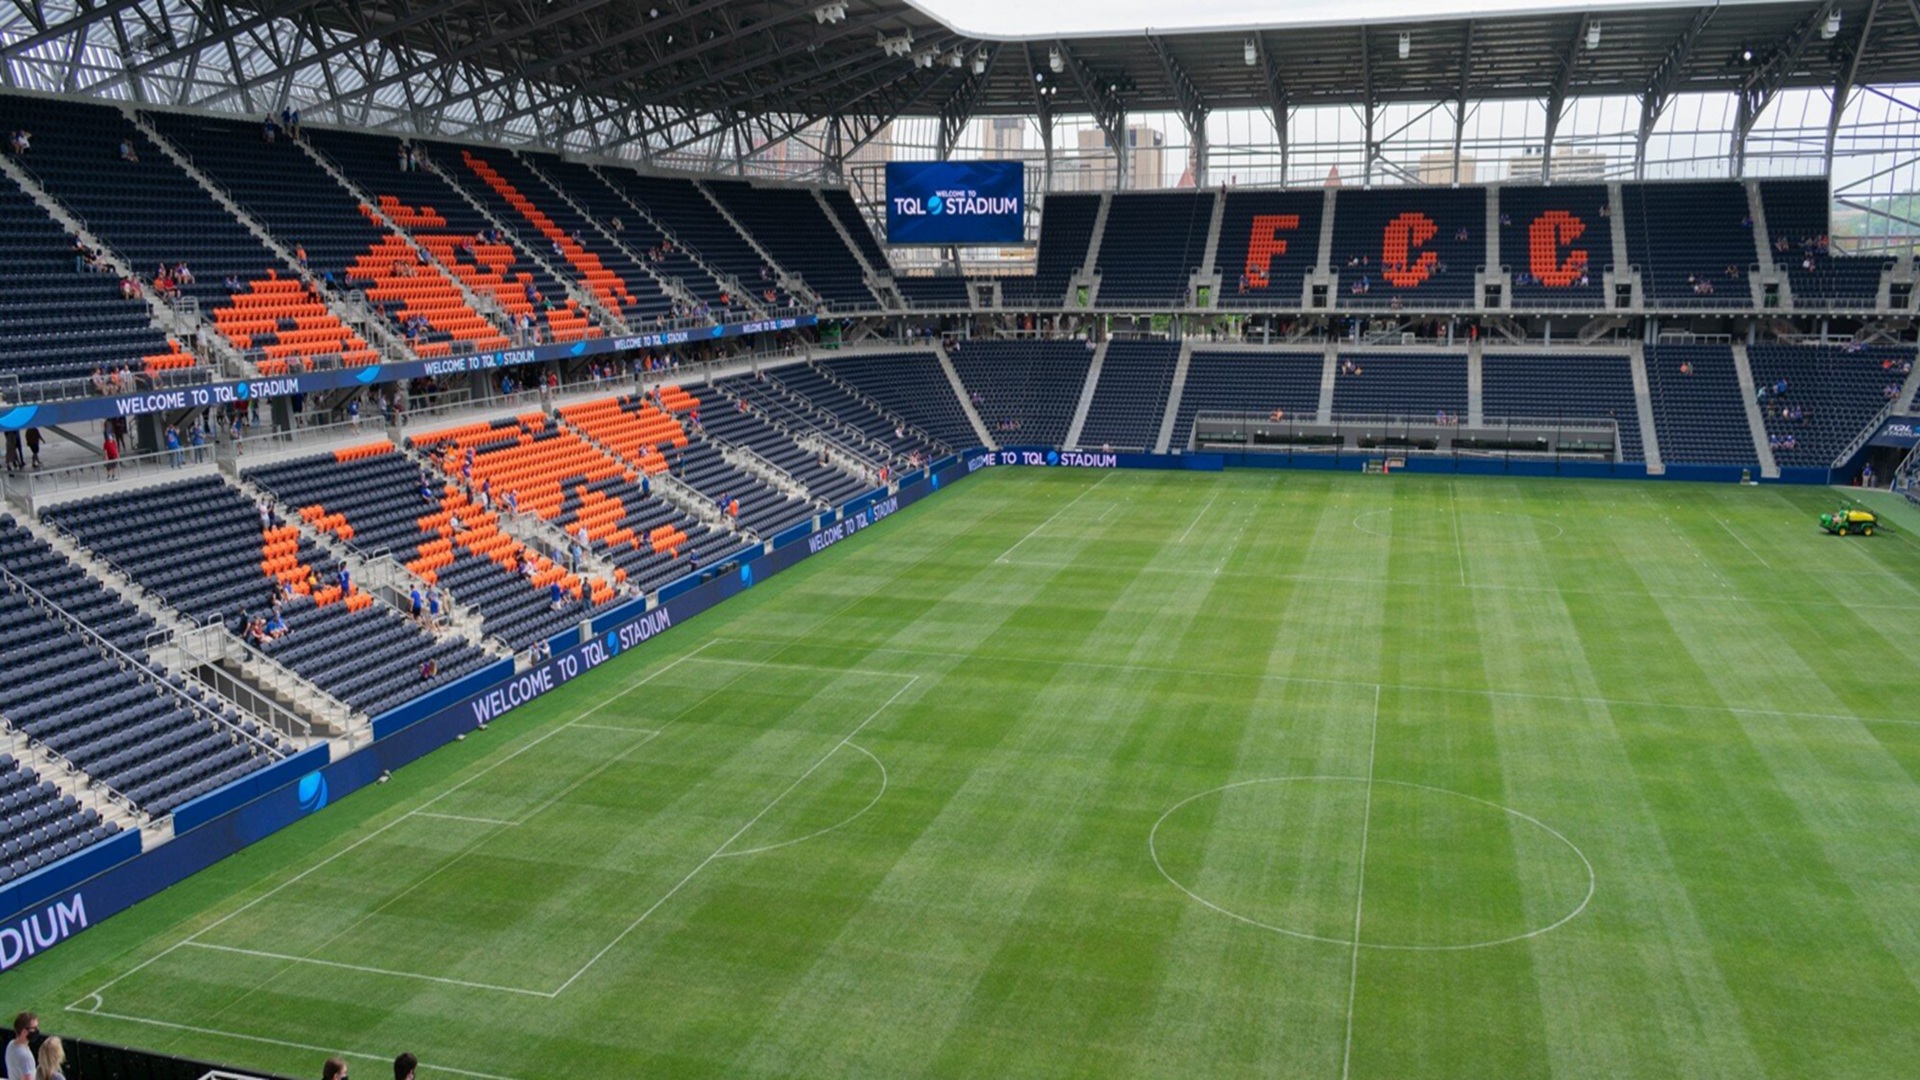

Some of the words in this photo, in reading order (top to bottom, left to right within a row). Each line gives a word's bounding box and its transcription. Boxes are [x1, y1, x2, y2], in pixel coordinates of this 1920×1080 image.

[894, 198, 927, 215] TQL
[946, 197, 1018, 215] STADIUM
[614, 336, 642, 350] WELCOME
[643, 335, 651, 346] TO
[652, 334, 662, 345] TQL
[667, 332, 689, 343] STADIUM
[424, 358, 466, 375] WELCOME
[468, 356, 480, 369] TO
[481, 355, 497, 368] TQL
[503, 350, 535, 365] STADIUM
[116, 391, 186, 414] WELCOME
[191, 391, 209, 405] TO
[213, 386, 238, 402] TQL
[250, 378, 299, 398] STADIUM
[1001, 452, 1017, 464] TO
[1022, 452, 1046, 465] TQL
[1060, 453, 1117, 467] STADIUM
[808, 523, 844, 553] WELCOME
[845, 518, 855, 535] TO
[856, 511, 869, 530] TQL
[873, 496, 899, 521] STADIUM
[472, 666, 554, 724] WELCOME
[557, 654, 578, 681] TO
[581, 641, 609, 669] TQL
[619, 607, 671, 649] STADIUM
